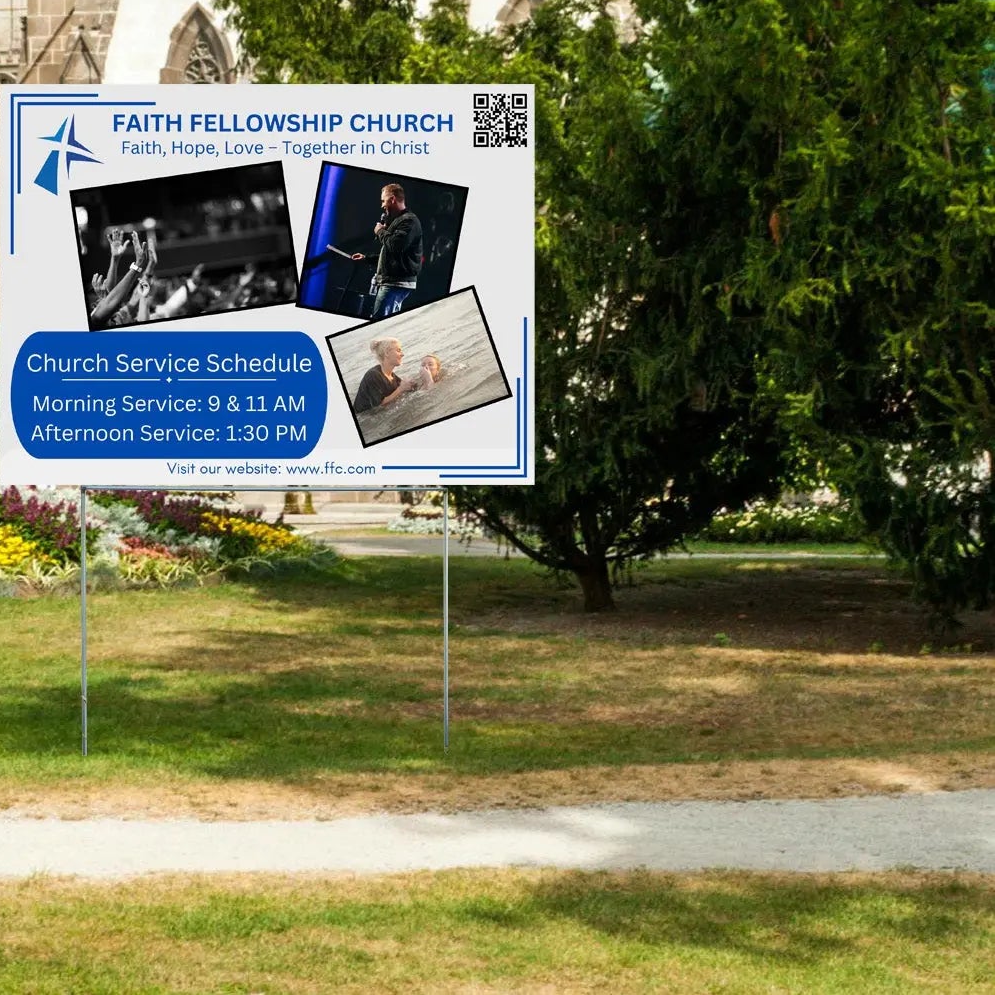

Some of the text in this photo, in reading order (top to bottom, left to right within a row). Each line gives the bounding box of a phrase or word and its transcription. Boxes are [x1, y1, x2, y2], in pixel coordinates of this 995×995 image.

[113, 113, 454, 133] FAITH FELLOWSHIP CHURCH
[121, 140, 167, 158] Faith,
[171, 140, 220, 159] Hope,
[225, 140, 264, 155] Love
[281, 140, 357, 159] Together
[361, 140, 376, 155] in
[380, 140, 430, 155] Christ
[27, 353, 312, 373] Church Service Schedule
[33, 394, 305, 417] Morning Service: 9 & 11 AM
[30, 423, 307, 442] Afternoon Service: 1:30 PM
[166, 461, 376, 475] Visit our website: www.ffc.com
